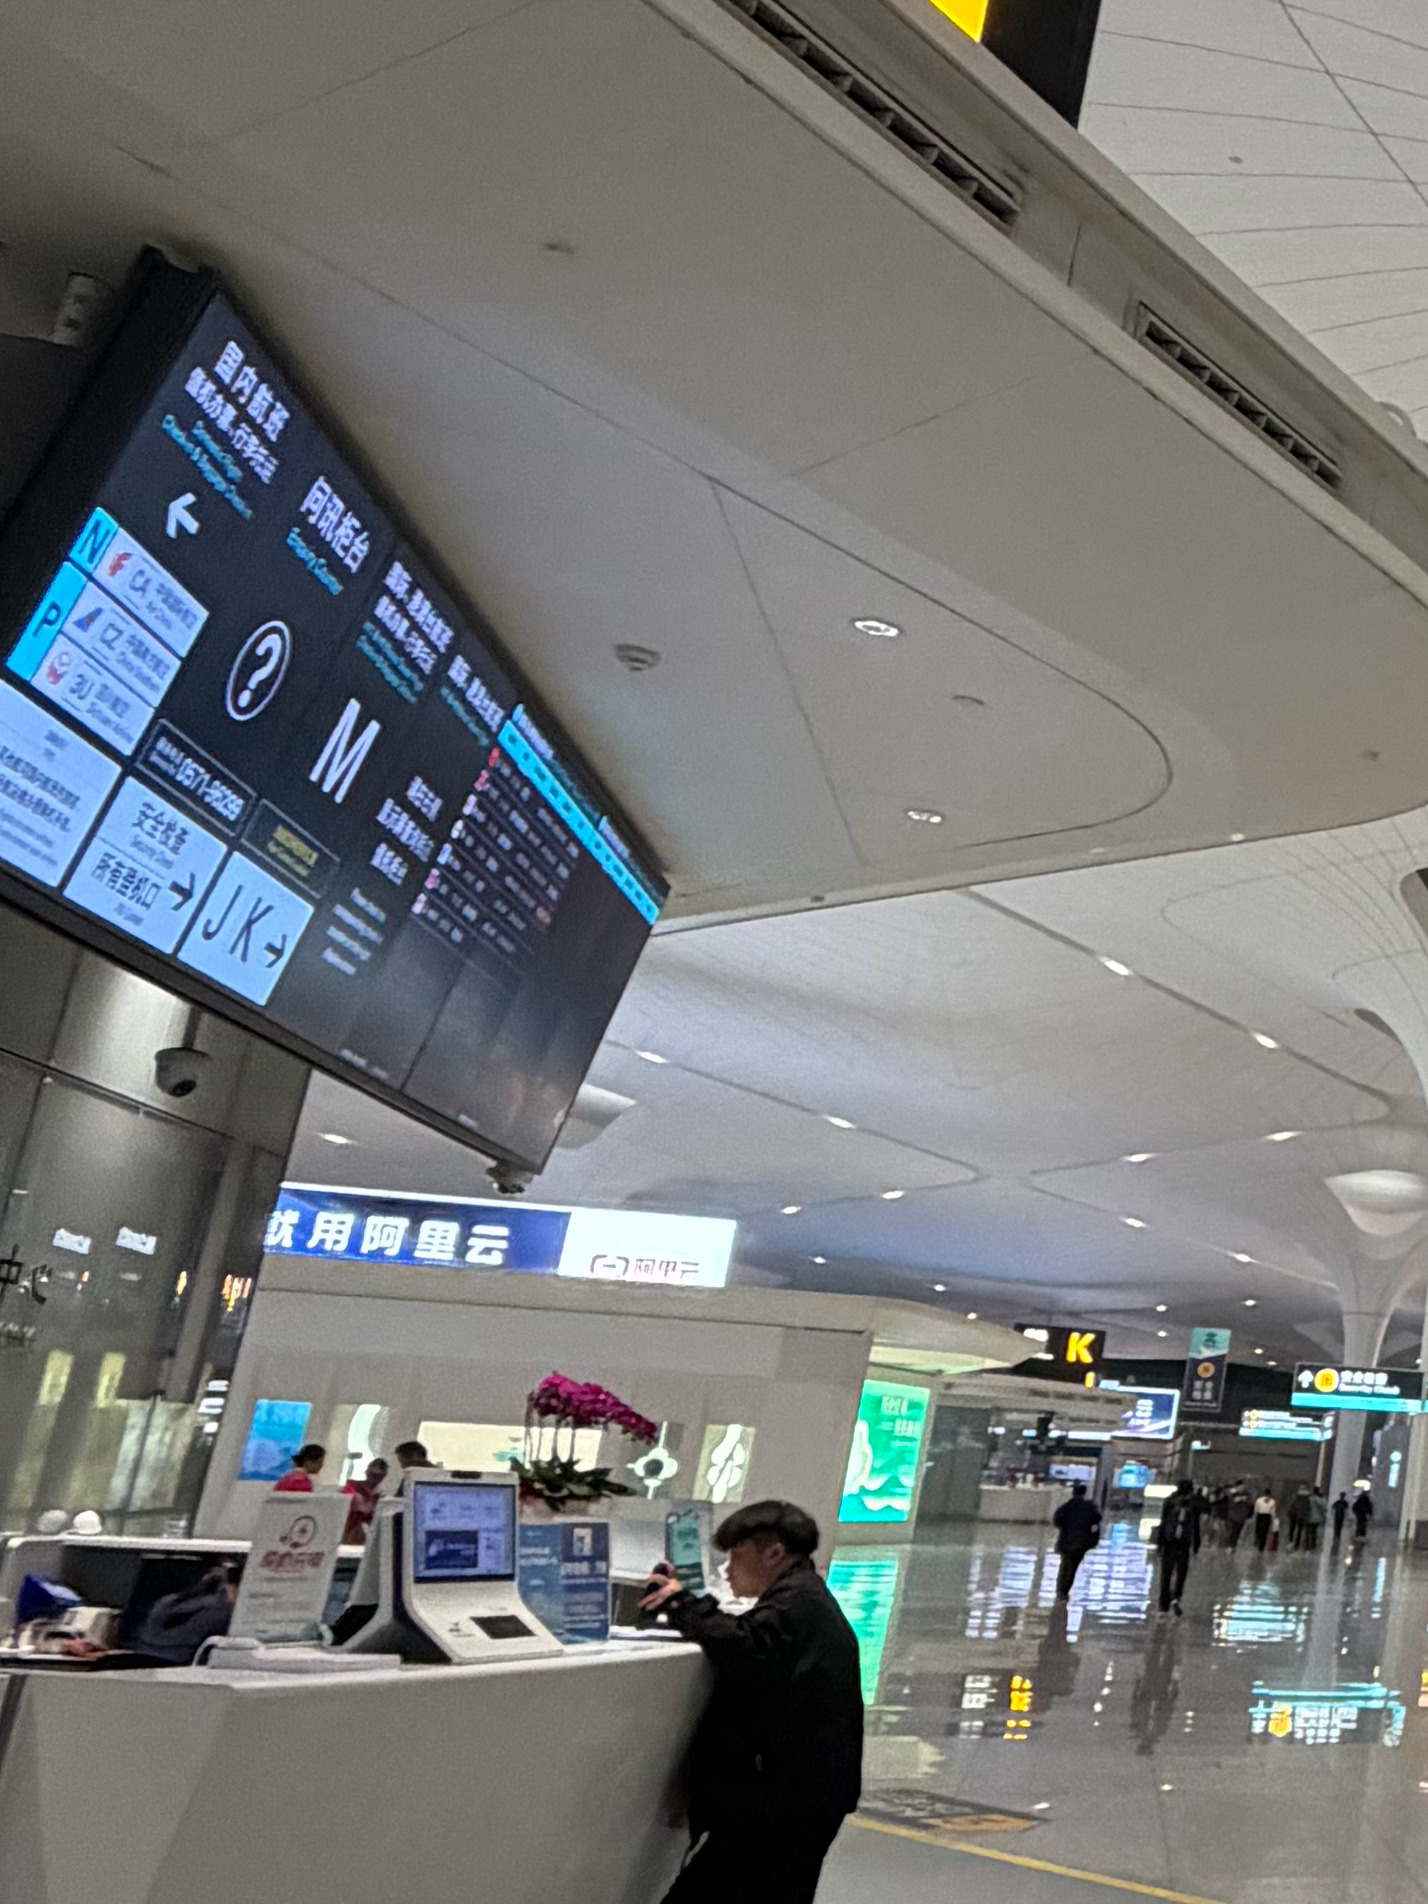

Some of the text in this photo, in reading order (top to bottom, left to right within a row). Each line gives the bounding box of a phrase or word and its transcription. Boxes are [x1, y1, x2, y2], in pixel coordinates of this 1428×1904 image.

[77, 518, 111, 565] N
[301, 477, 369, 572] 问讯柜台
[128, 568, 152, 598] CA
[32, 601, 62, 638] P
[99, 621, 125, 652] CZ
[68, 673, 95, 701] 3U
[310, 699, 380, 803] M
[131, 802, 189, 856] 安全检查
[92, 852, 162, 910] 所有登机口
[201, 884, 244, 941] J
[229, 896, 275, 963] K
[1066, 1332, 1096, 1364] K
